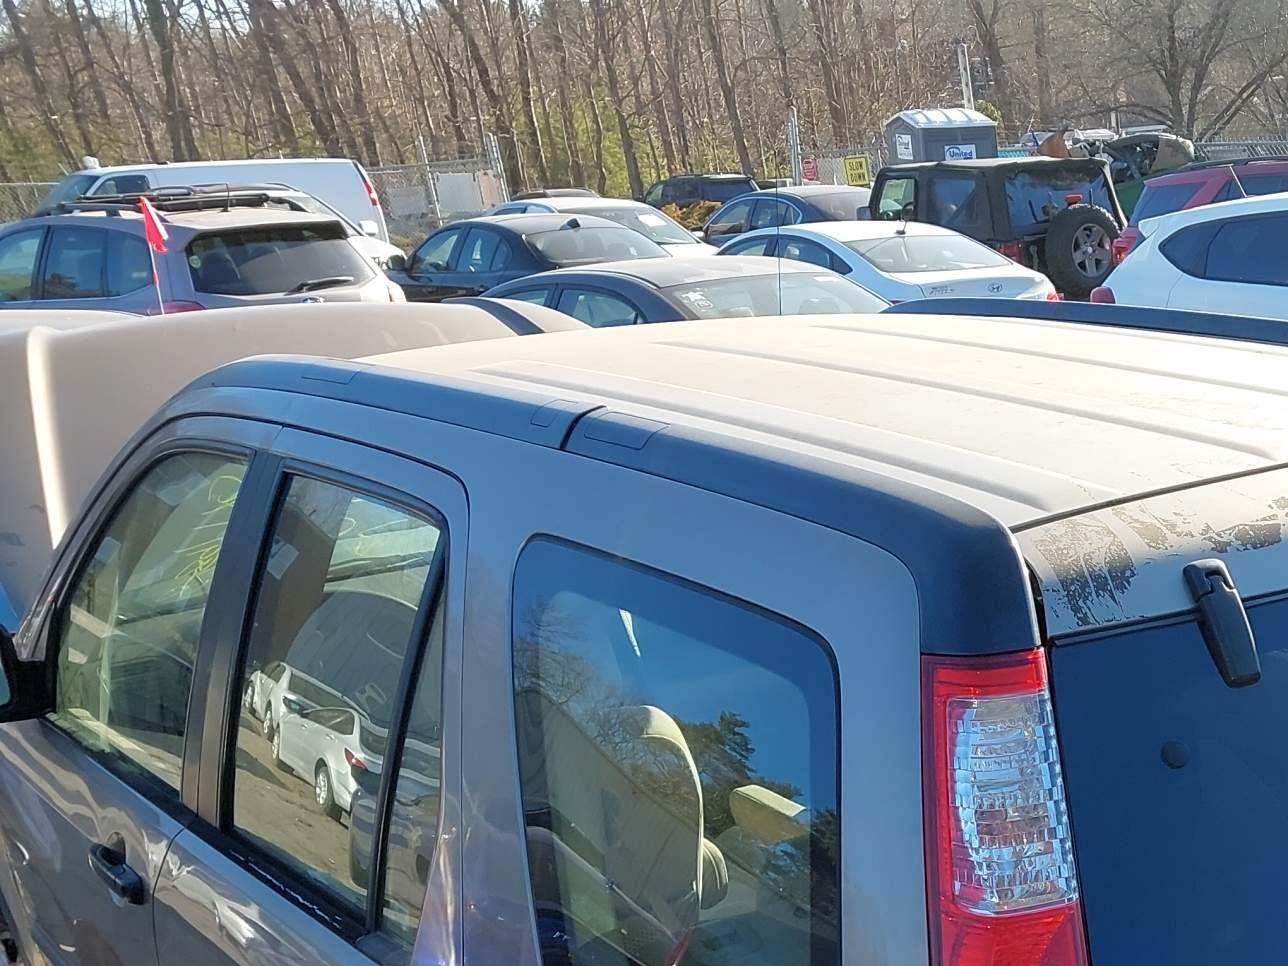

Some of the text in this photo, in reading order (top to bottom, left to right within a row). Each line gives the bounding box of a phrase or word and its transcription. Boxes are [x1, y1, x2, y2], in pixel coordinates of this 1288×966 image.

[949, 149, 973, 158] United
[848, 160, 864, 171] SLOW
[850, 172, 866, 183] DOWN
